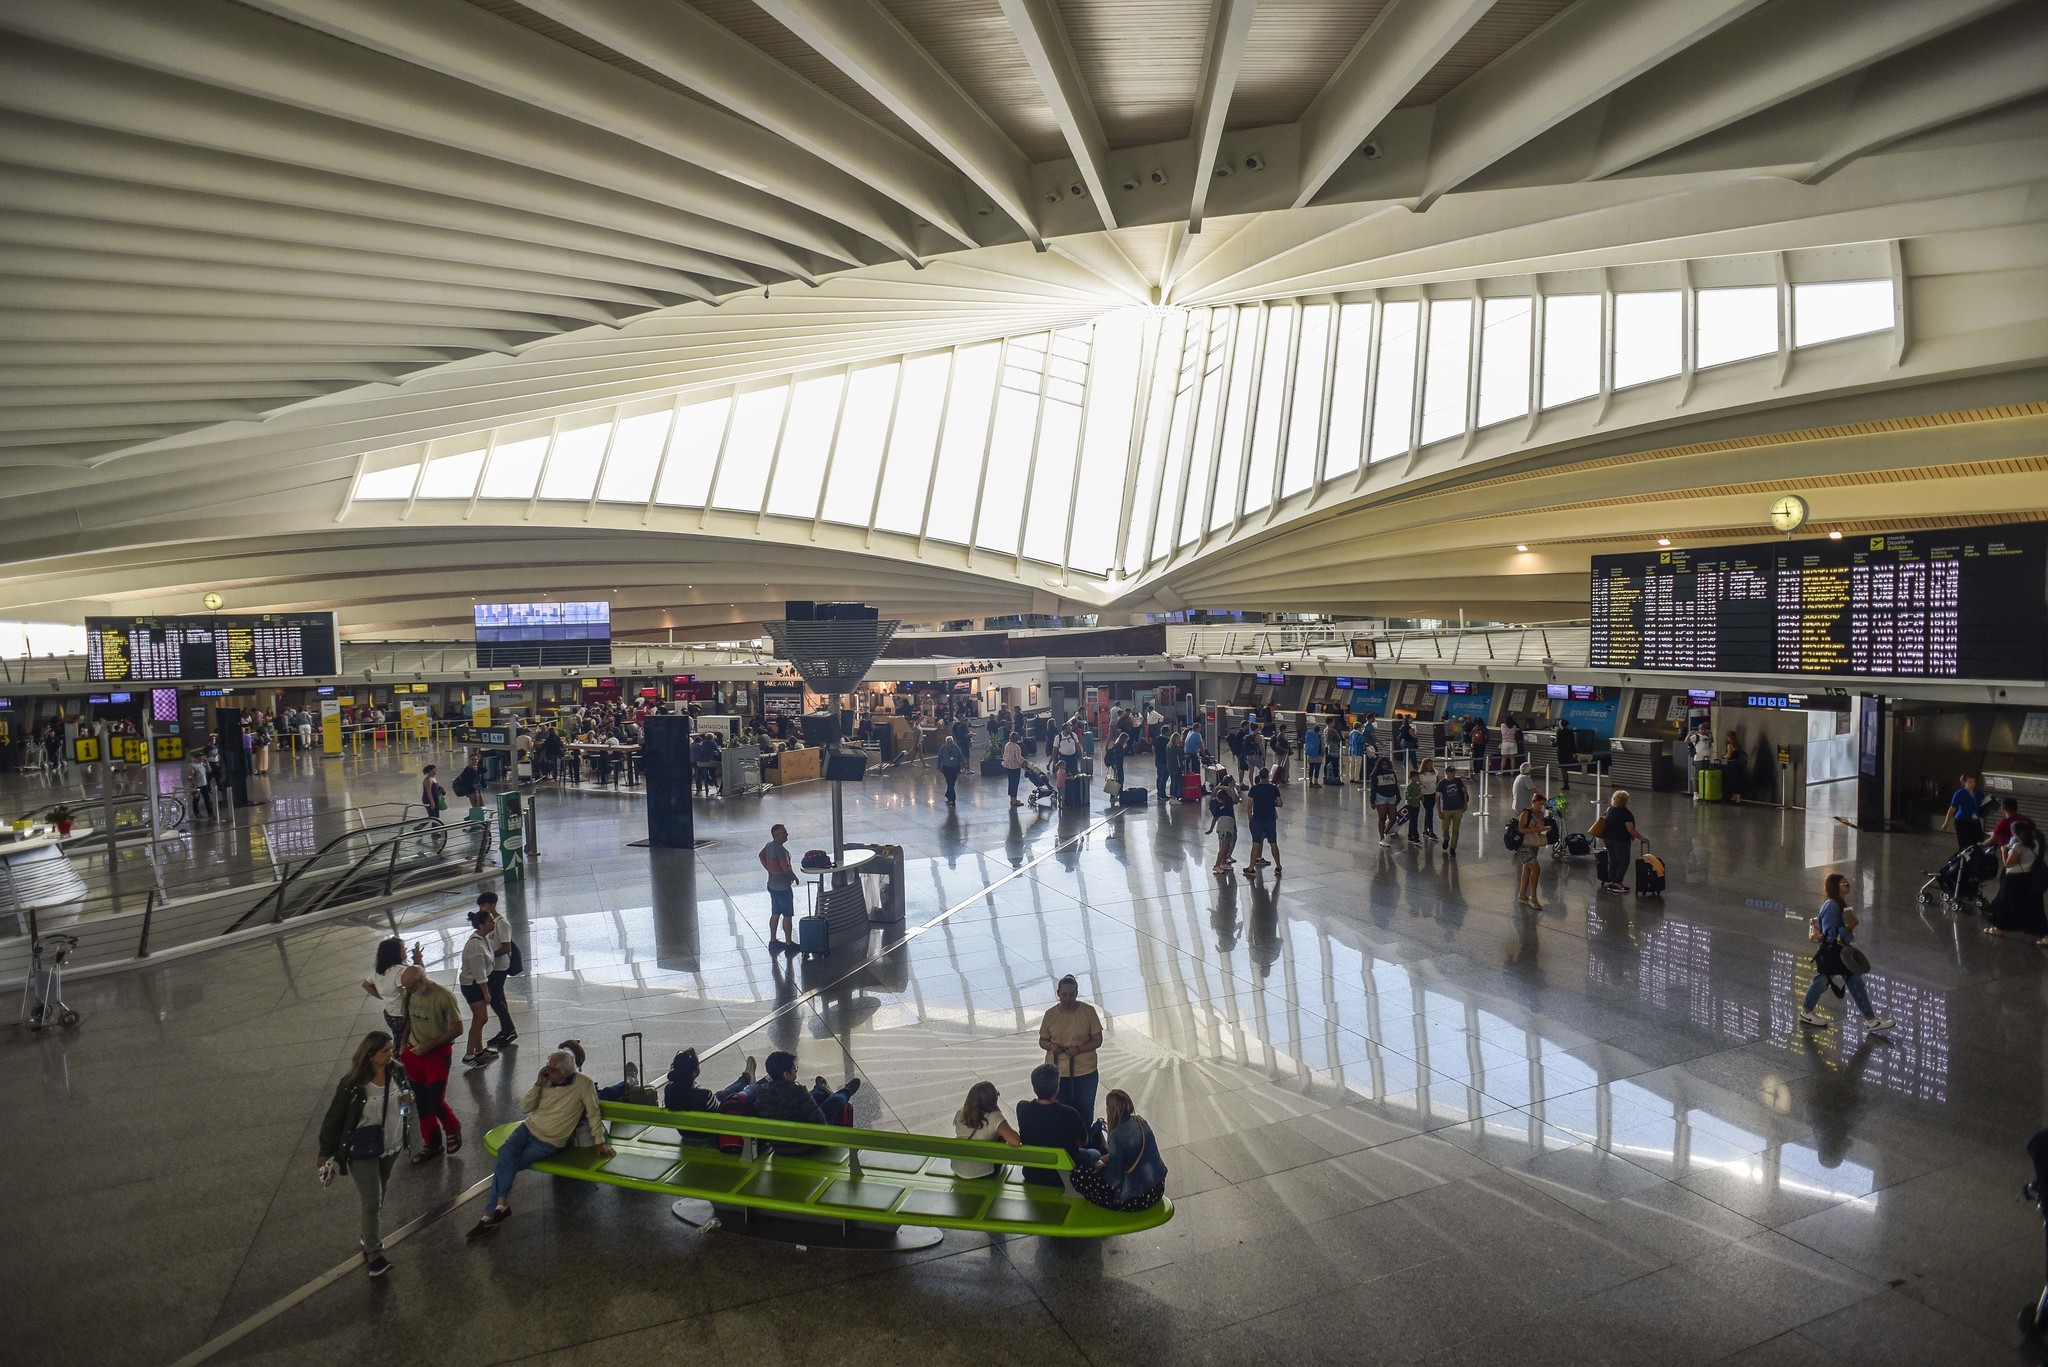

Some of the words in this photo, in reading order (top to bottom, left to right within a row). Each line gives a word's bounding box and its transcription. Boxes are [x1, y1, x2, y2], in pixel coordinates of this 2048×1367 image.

[406, 694, 431, 702] vueling
[498, 692, 523, 700] vueling
[1596, 694, 1604, 702] 26
[1453, 702, 1484, 710] groundforce
[1569, 709, 1608, 718] groundforce
